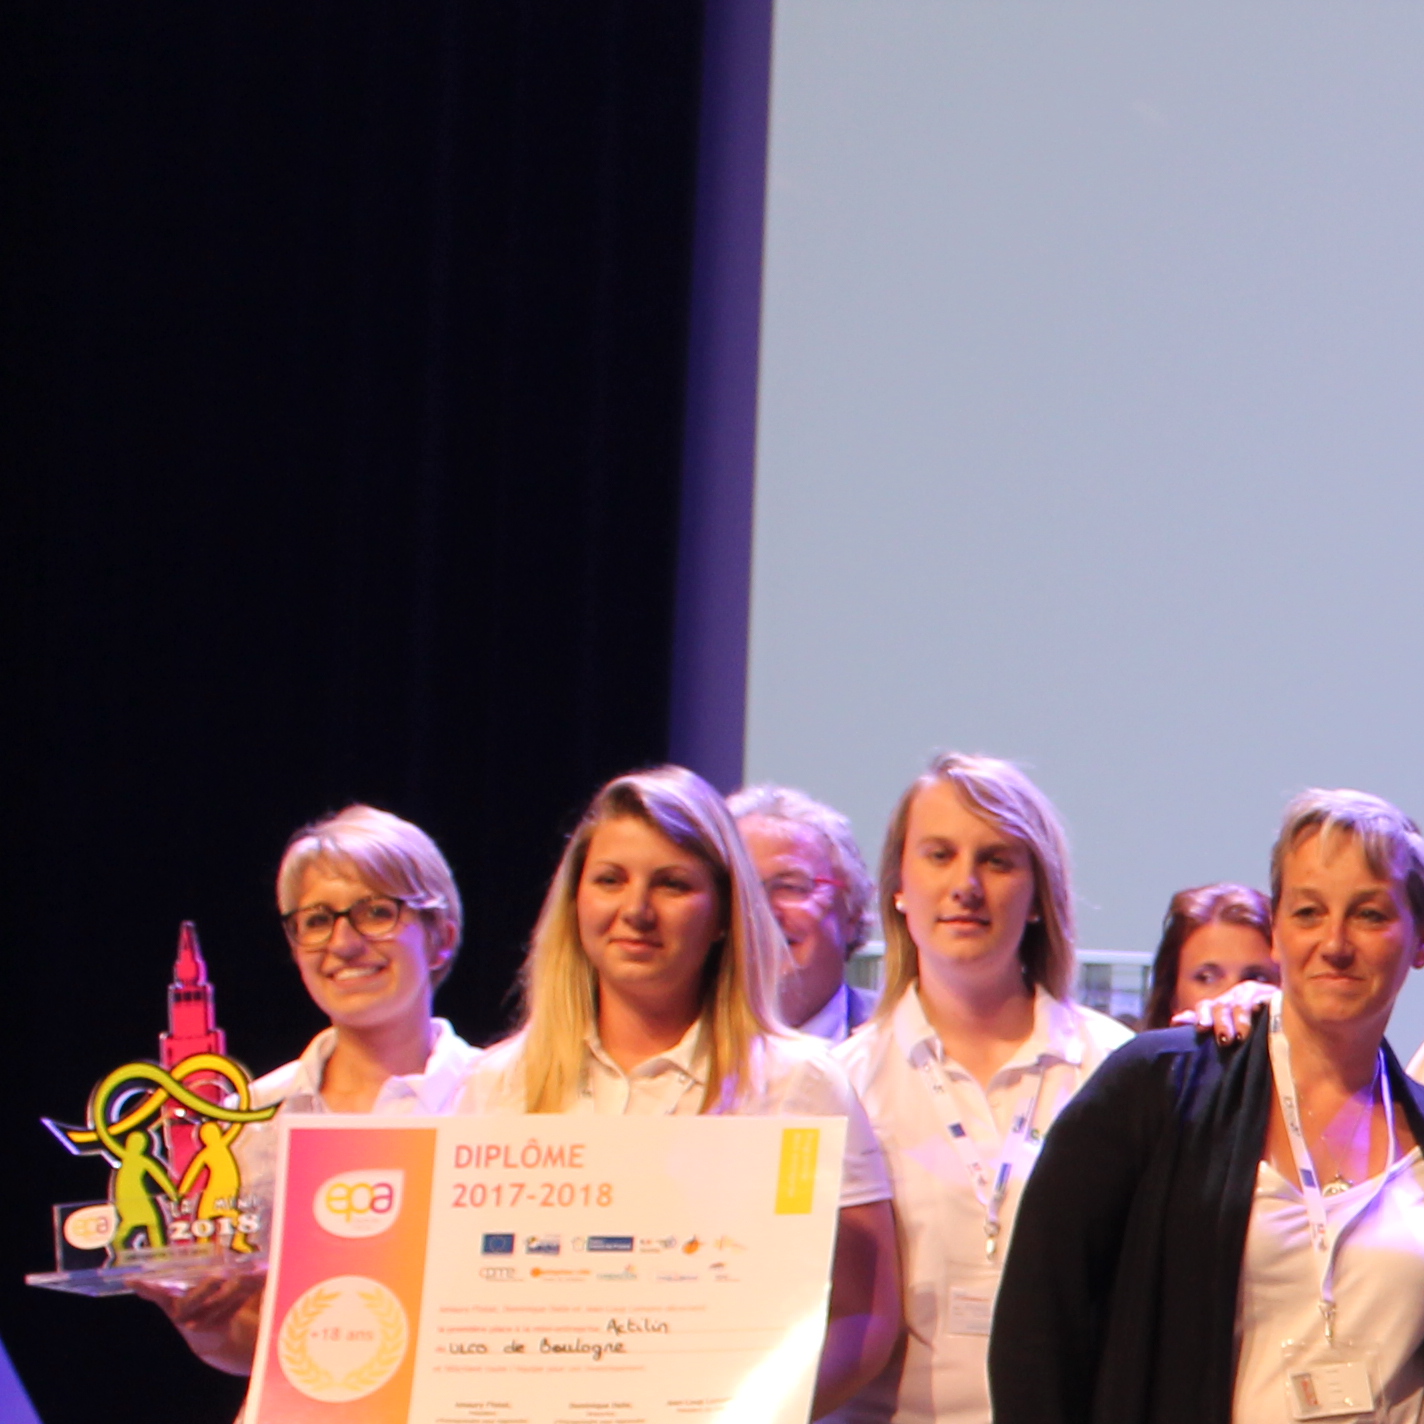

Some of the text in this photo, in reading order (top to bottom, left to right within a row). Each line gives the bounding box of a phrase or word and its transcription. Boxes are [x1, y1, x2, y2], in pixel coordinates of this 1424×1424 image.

[452, 1137, 587, 1169] DIPLÔME
[325, 1182, 394, 1223] epa
[451, 1182, 614, 1208] 2017-2018
[169, 1213, 261, 1241] 2018
[504, 1341, 525, 1353] de
[540, 1337, 628, 1362] Boulogne
